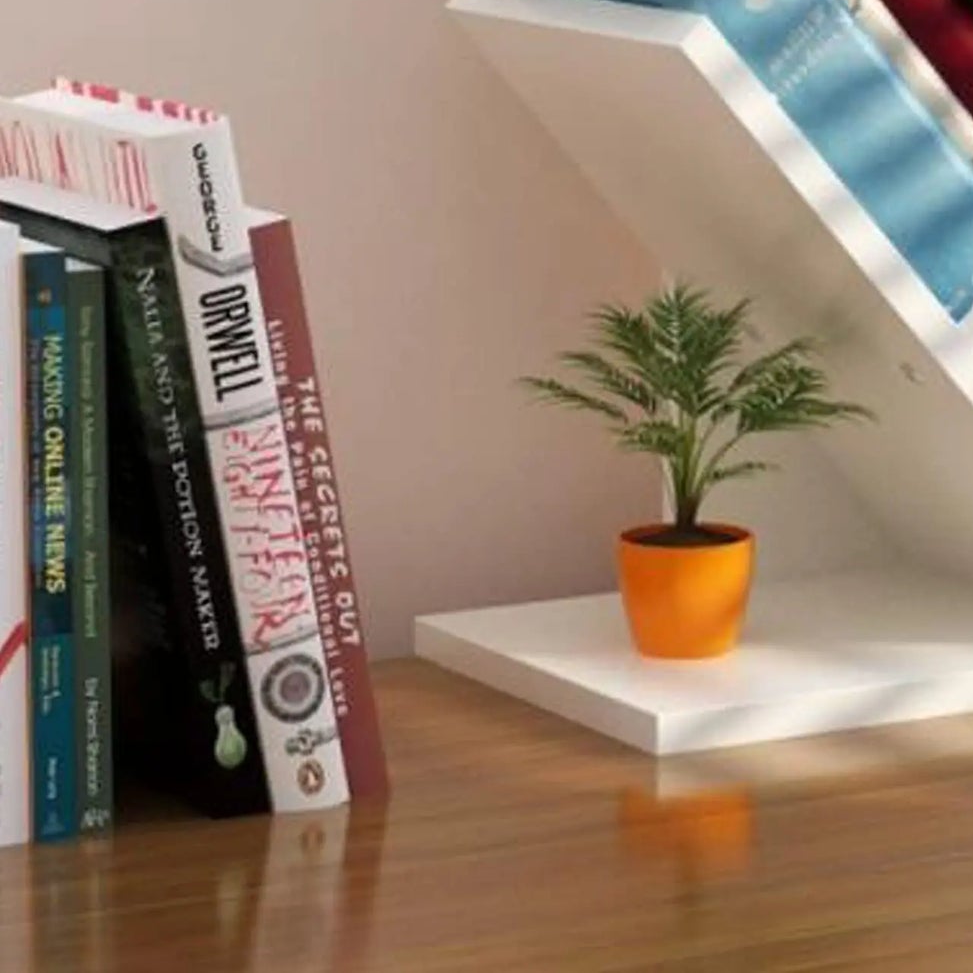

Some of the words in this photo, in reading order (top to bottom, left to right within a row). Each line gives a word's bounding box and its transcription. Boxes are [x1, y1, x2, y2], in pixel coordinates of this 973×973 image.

[190, 142, 225, 252] GEORGE
[42, 335, 62, 419] MAKING
[151, 352, 175, 406] AND
[198, 283, 263, 402] ORWELL
[267, 318, 289, 386] Living
[161, 407, 183, 456] THE
[280, 395, 301, 431] the
[44, 426, 65, 517] ONLINE
[288, 441, 310, 490] Pain
[170, 460, 203, 559] POTION
[249, 422, 309, 621] NINETEEN
[296, 377, 323, 434] THE
[334, 589, 360, 648] OUT
[298, 500, 316, 522] of
[45, 523, 65, 593] NEWS
[189, 564, 219, 651] MAKER
[330, 667, 348, 720] Love
